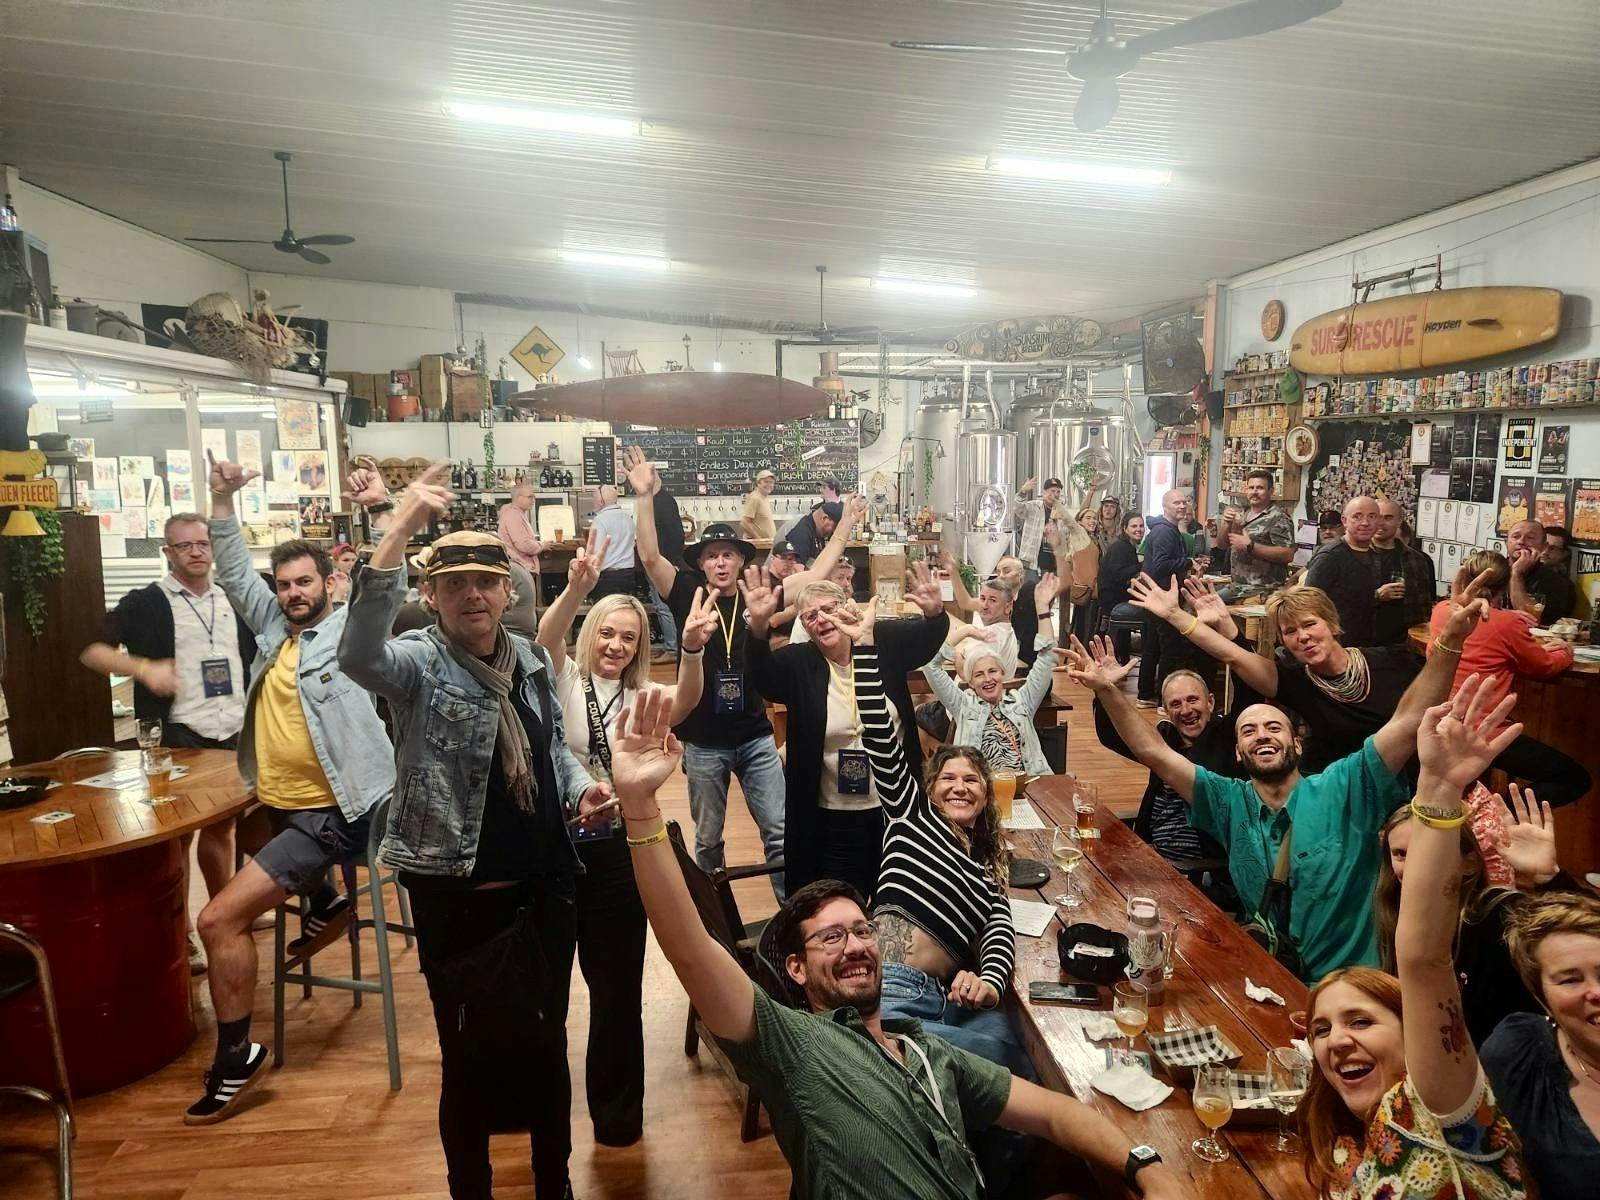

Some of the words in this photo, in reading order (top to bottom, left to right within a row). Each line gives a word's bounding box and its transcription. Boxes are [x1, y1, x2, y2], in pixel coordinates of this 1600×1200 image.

[1352, 315, 1418, 350] RESCUE
[1503, 438, 1538, 448] INDEPENDENT
[699, 459, 730, 470] Endless
[733, 460, 754, 471] Daze
[1505, 460, 1531, 468] SUPPORTER
[707, 468, 750, 483] Longboard
[782, 471, 804, 481] IRISH
[0, 485, 19, 502] DEN
[20, 484, 55, 502] FLEECE
[1578, 554, 1595, 573] LOOK
[587, 701, 607, 747] COUNTRY
